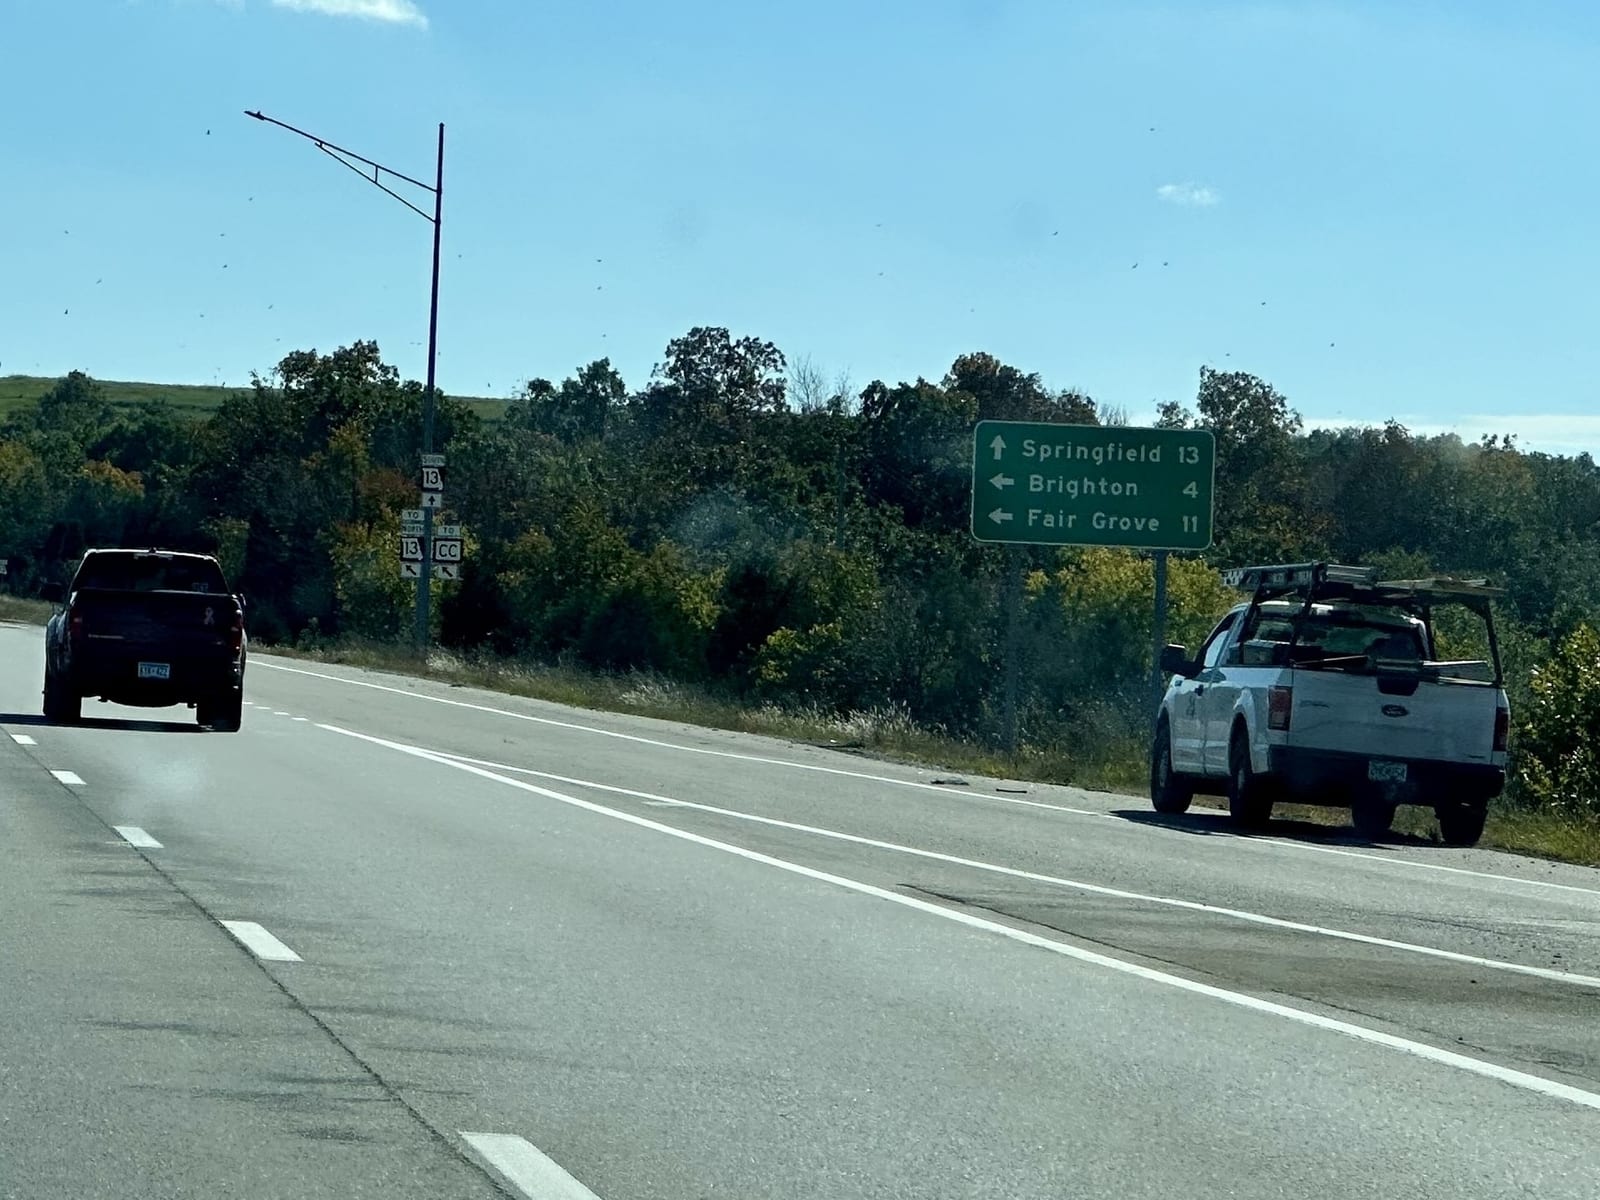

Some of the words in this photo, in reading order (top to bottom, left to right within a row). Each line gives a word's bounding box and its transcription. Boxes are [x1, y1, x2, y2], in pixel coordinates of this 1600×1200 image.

[1022, 439, 1161, 465] Springfield
[1178, 446, 1200, 464] 13
[426, 471, 439, 484] 13
[1028, 474, 1138, 499] Brighton
[1182, 481, 1199, 498] 4
[408, 511, 418, 519] TO
[1028, 509, 1077, 528] Fair
[1092, 512, 1160, 531] Grove
[1182, 515, 1198, 533] 11
[406, 541, 418, 555] 13
[439, 544, 457, 557] CC
